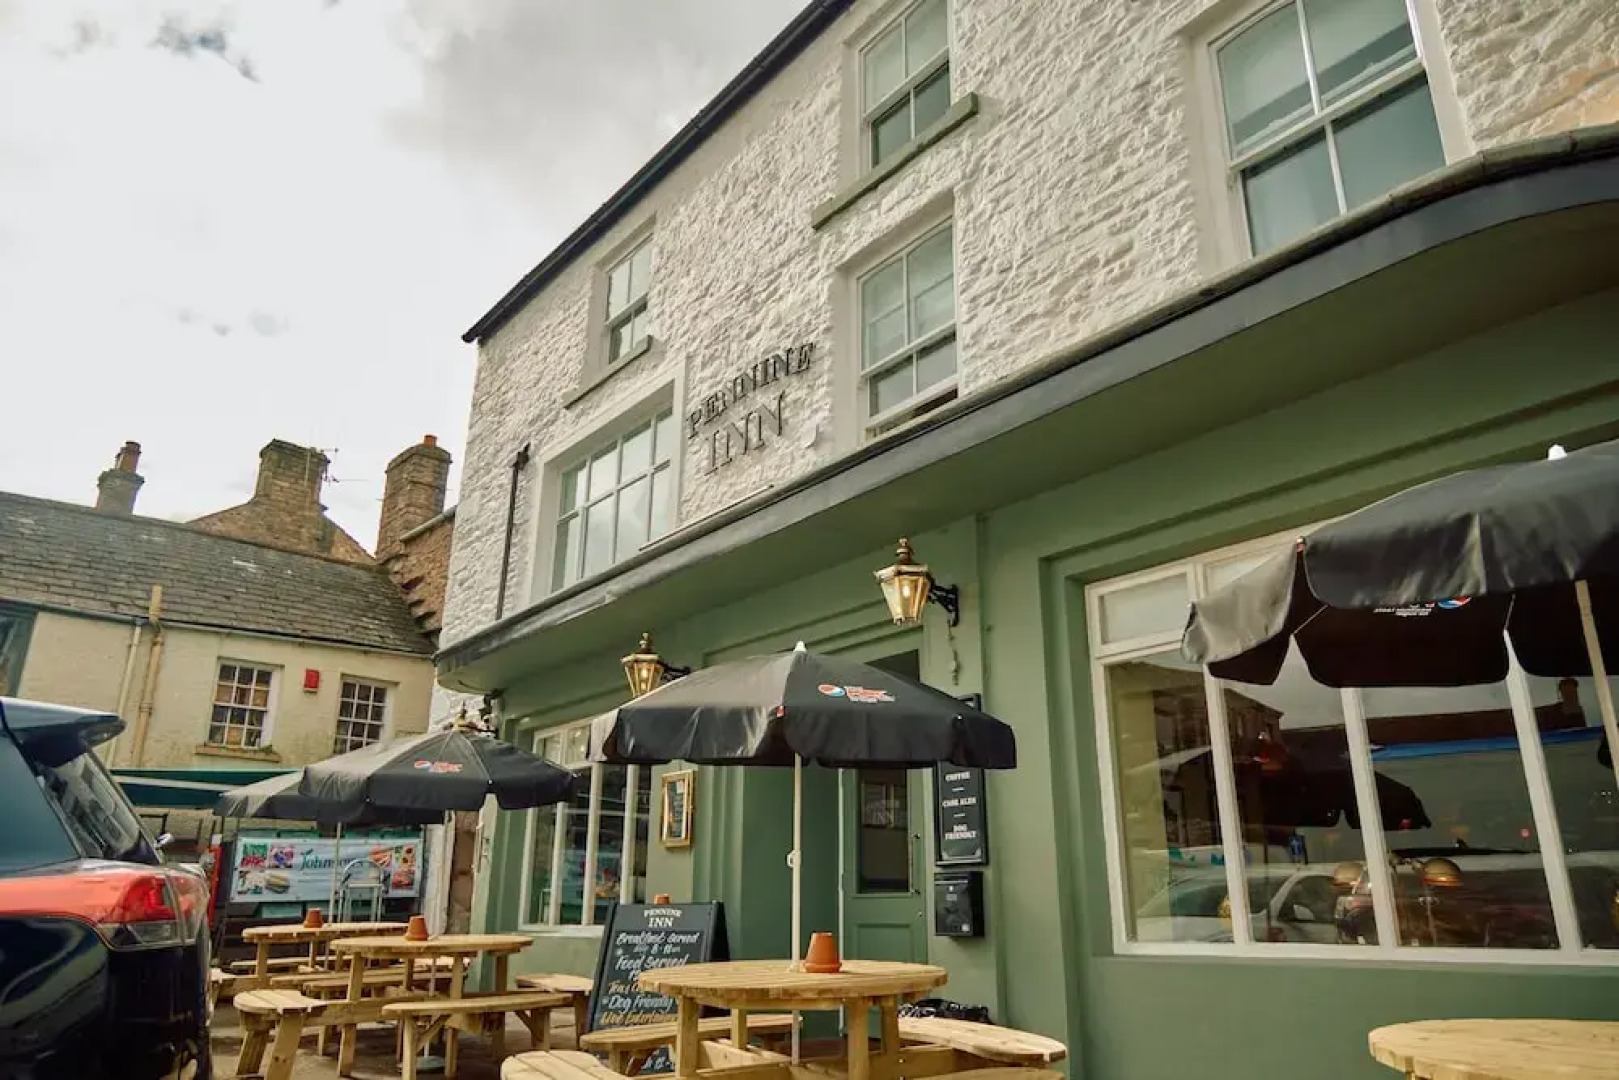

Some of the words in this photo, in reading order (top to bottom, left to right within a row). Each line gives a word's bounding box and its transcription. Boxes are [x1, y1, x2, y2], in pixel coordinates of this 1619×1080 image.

[686, 343, 816, 439] PENNINE
[704, 390, 786, 476] INN
[945, 771, 971, 782] COFFEE
[953, 823, 968, 832] DOG
[945, 831, 977, 841] FRIENDLY
[643, 908, 682, 918] PENNINE
[649, 917, 675, 928] INN
[616, 931, 666, 946] Breakfast
[666, 931, 700, 944] Served
[614, 954, 646, 972] Food
[644, 953, 690, 969] Served
[608, 995, 633, 1014] Dog
[632, 996, 674, 1013] Friendly
